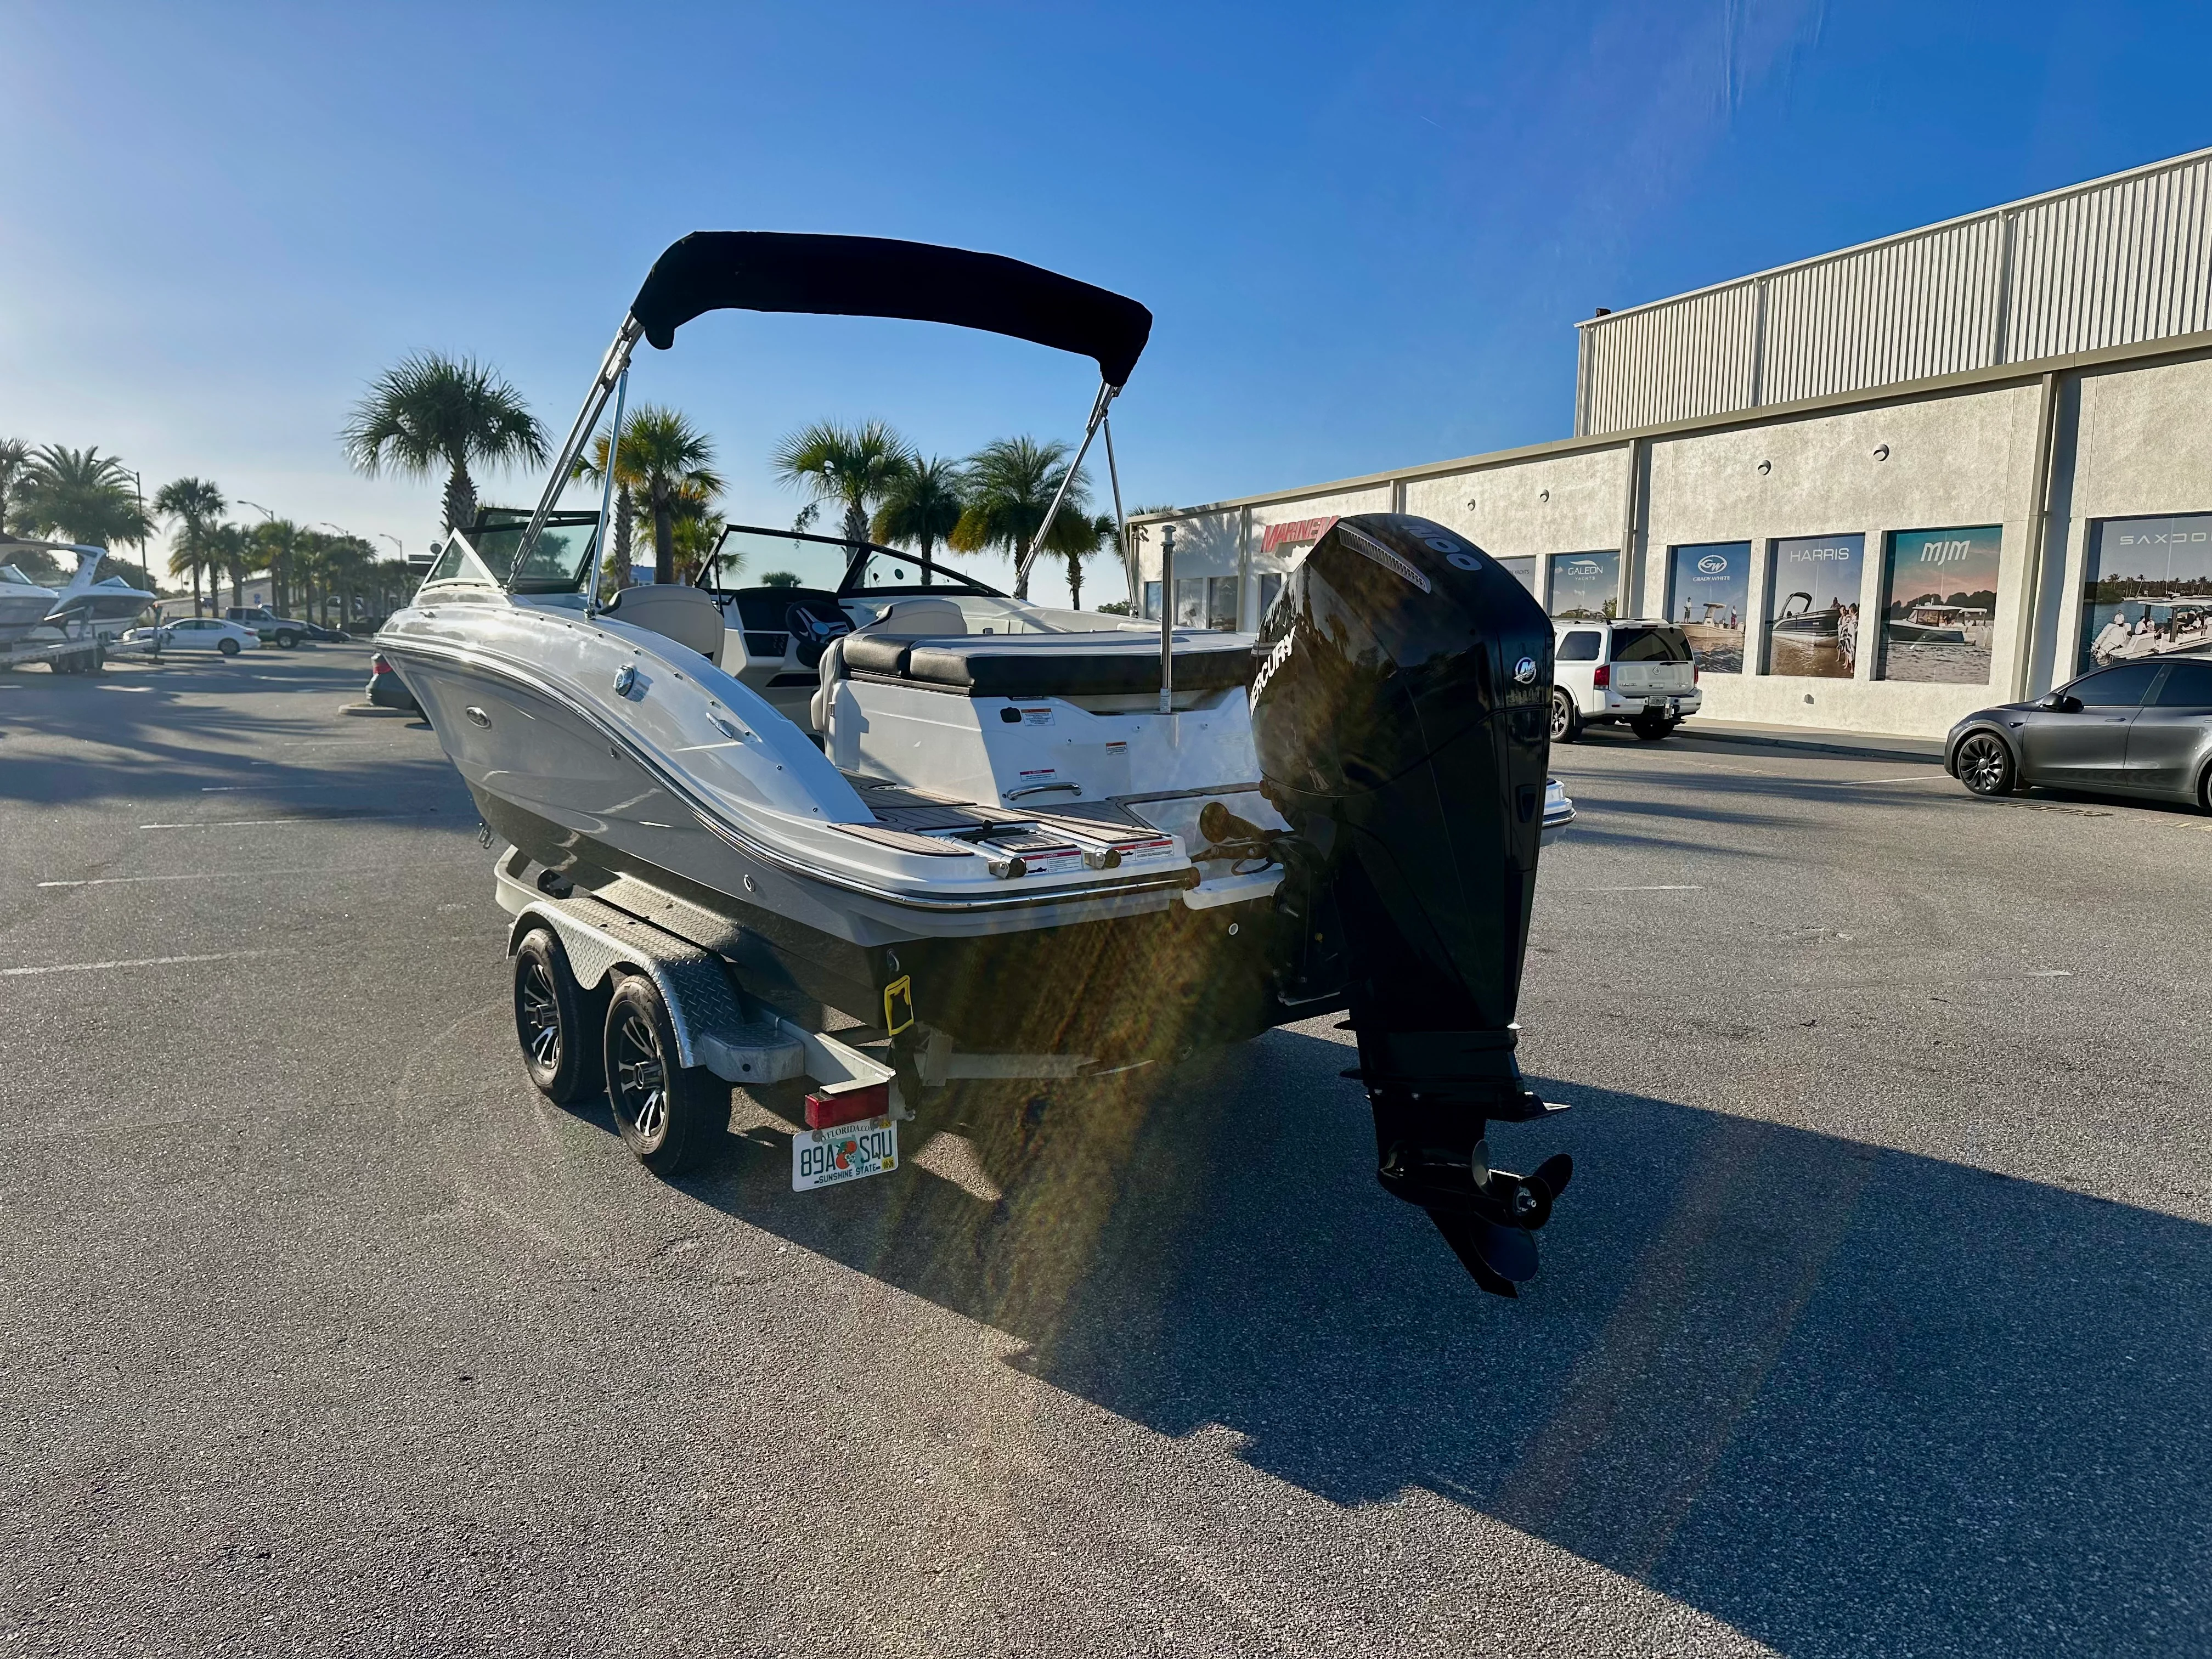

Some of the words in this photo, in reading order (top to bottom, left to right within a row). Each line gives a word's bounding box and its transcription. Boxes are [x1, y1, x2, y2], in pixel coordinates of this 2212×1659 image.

[1401, 525, 1482, 571] 200
[2120, 532, 2212, 545] SAXDO
[1790, 548, 1849, 562] HARRIS
[1568, 566, 1604, 575] GALEON
[1250, 625, 1296, 720] MERCURY
[800, 1144, 836, 1177] 89A
[859, 1130, 893, 1164] SQU
[819, 1169, 853, 1183] SUNSHINE
[856, 1164, 877, 1176] STATE
